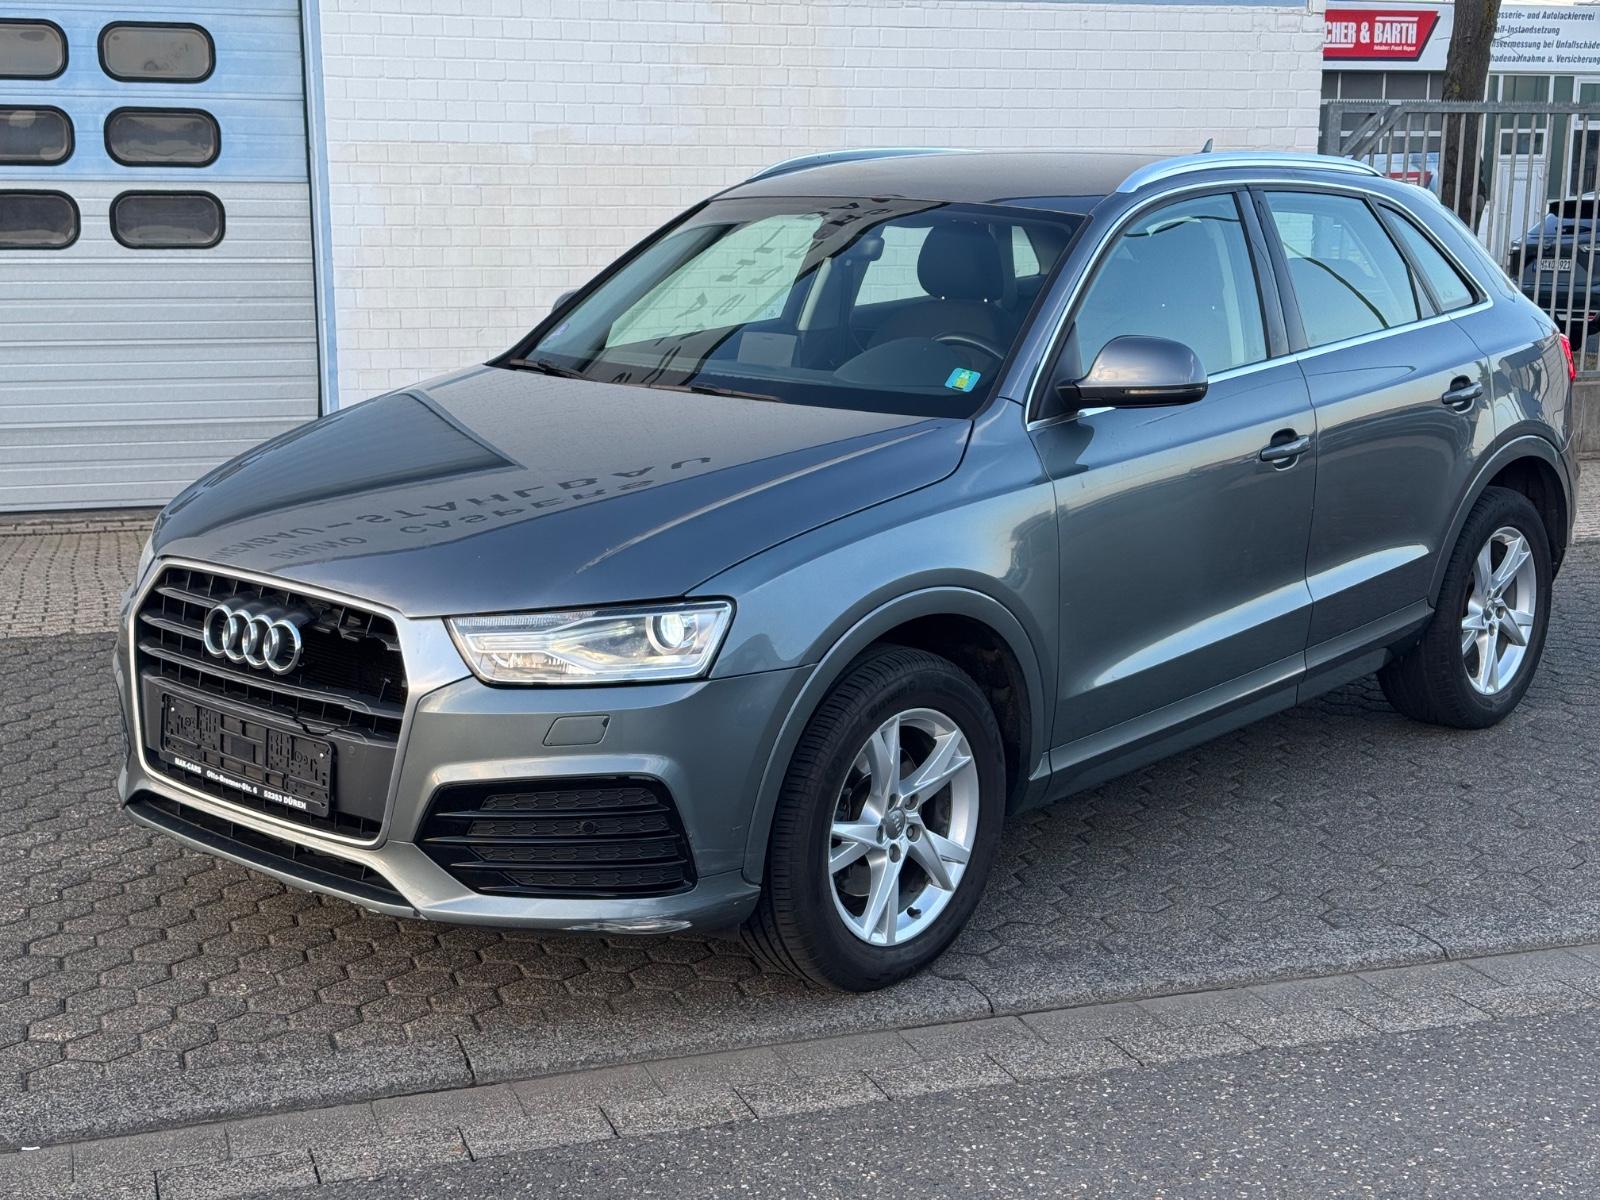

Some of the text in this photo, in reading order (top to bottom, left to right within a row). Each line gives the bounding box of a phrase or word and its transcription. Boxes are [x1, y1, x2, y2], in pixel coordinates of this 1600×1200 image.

[1527, 12, 1541, 20] und
[1325, 21, 1418, 44] CHER & BARTH
[1543, 40, 1555, 48] bei
[283, 795, 307, 810] DÜREN
